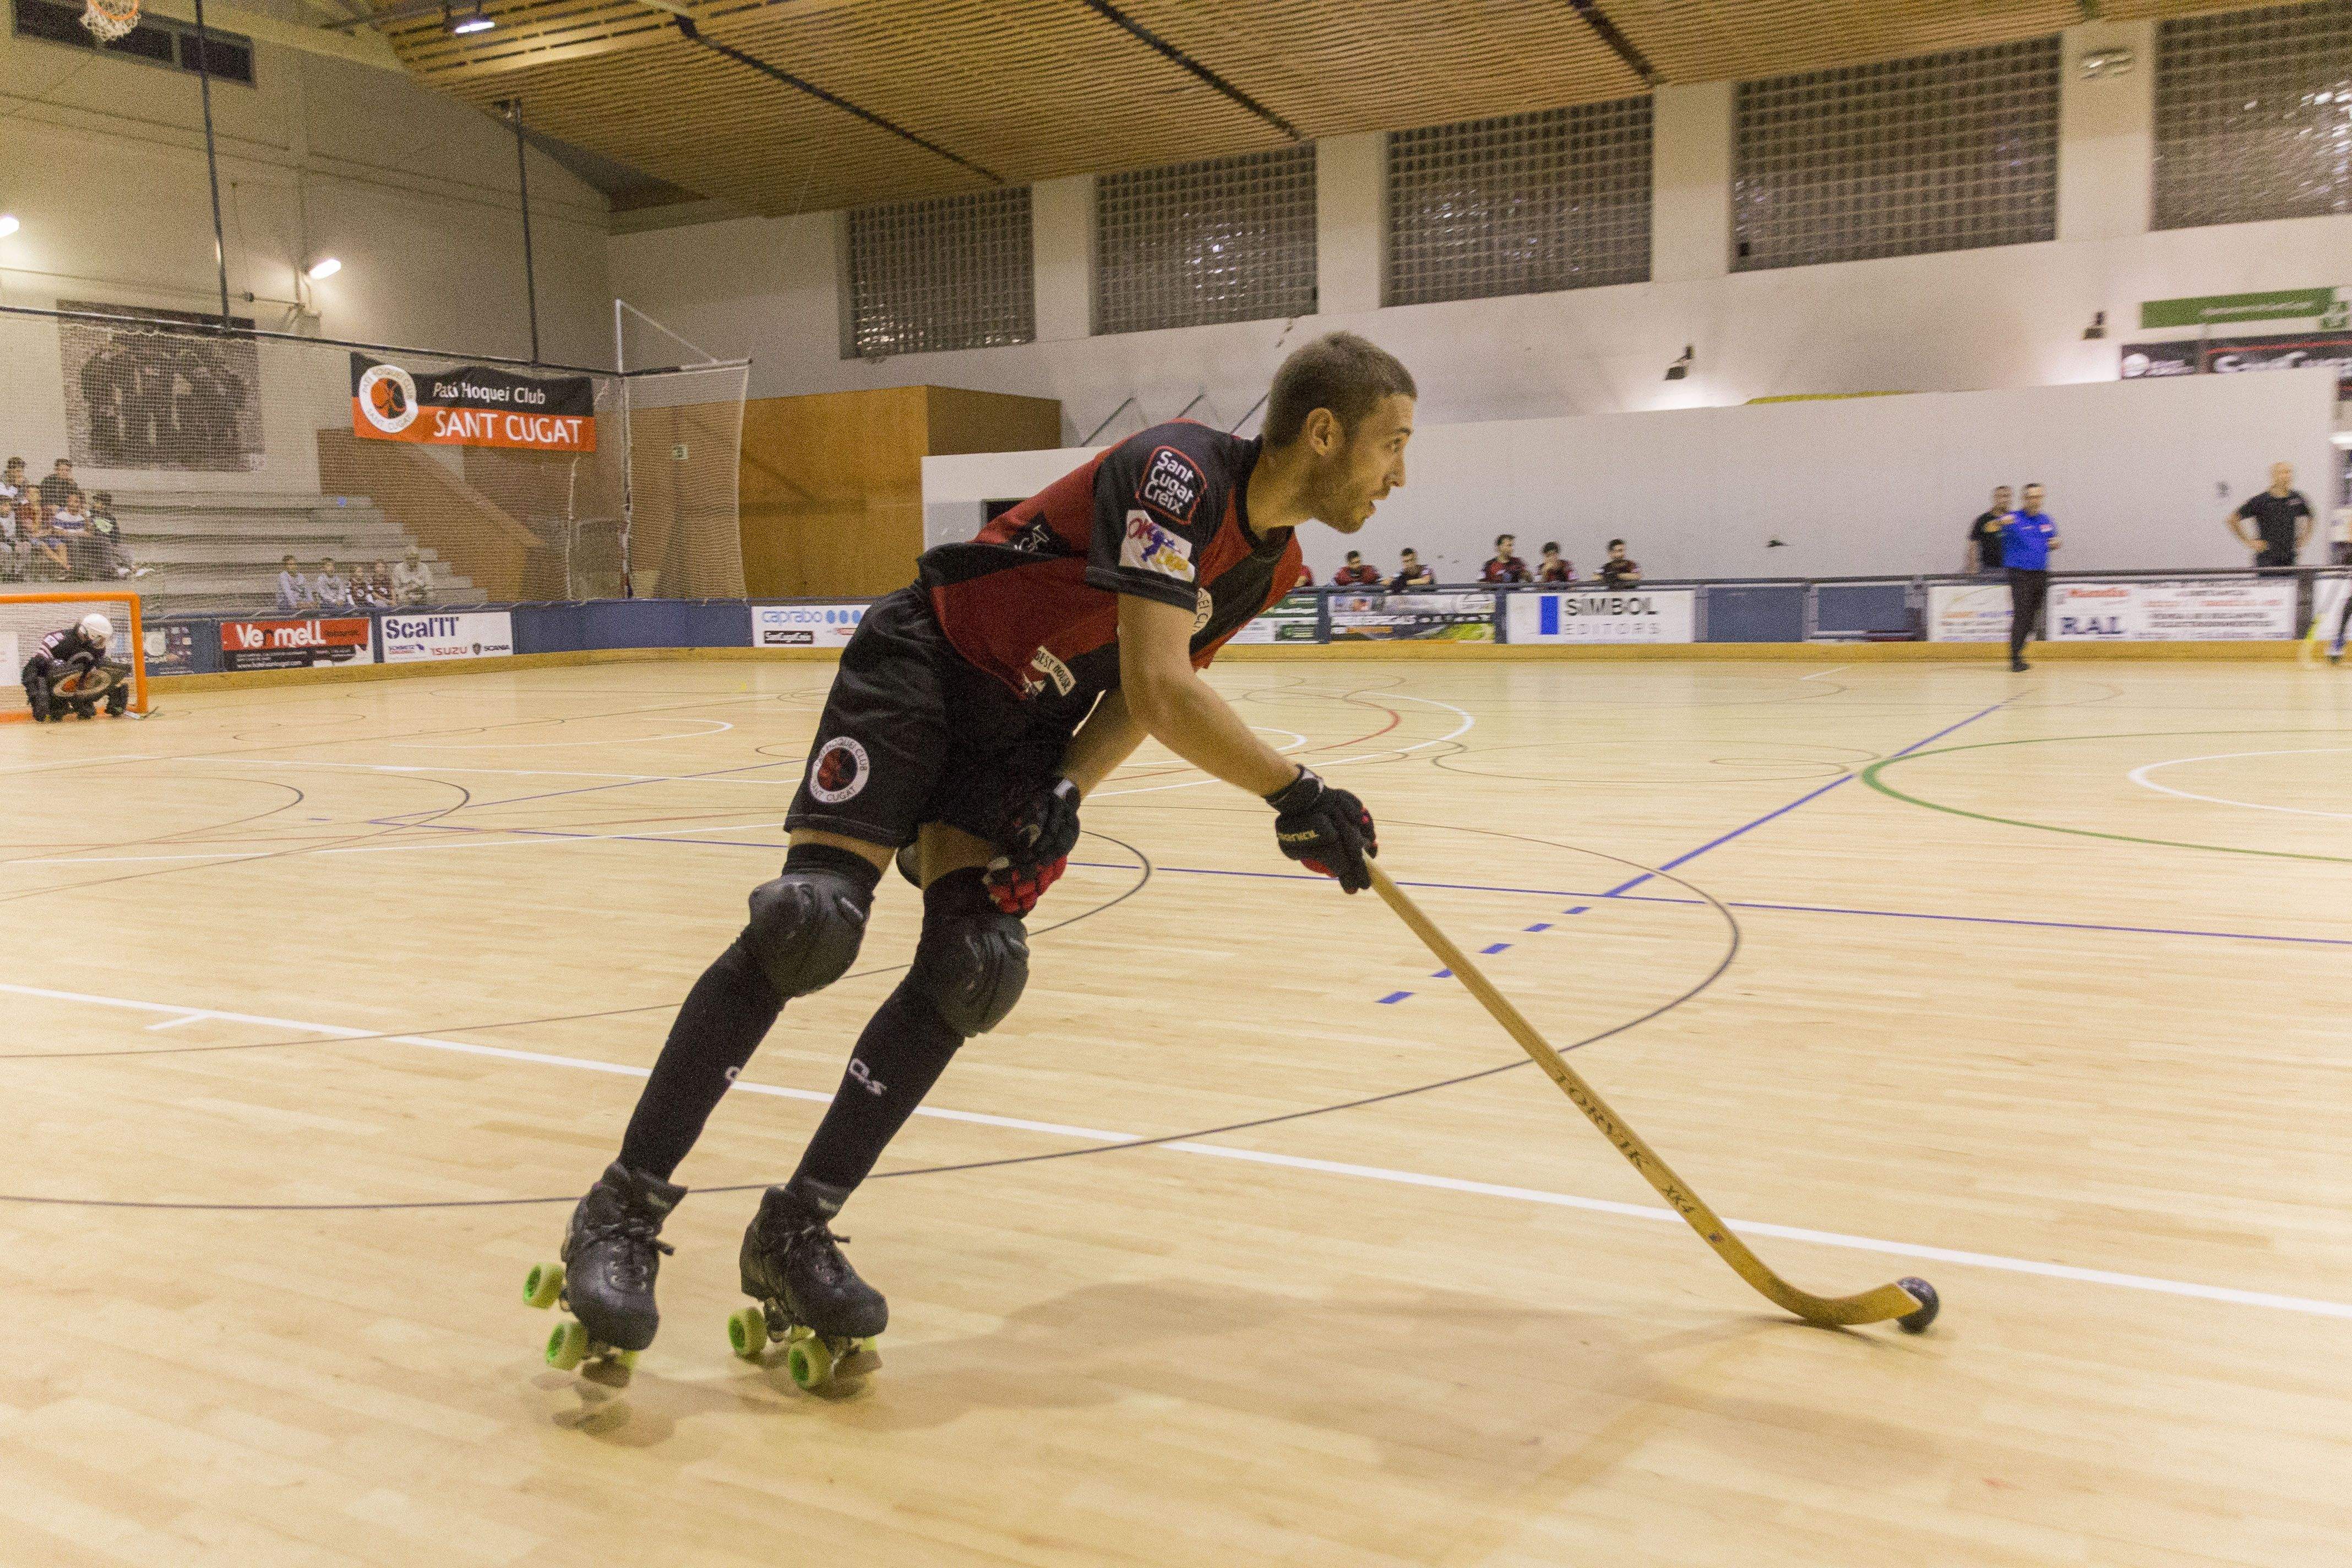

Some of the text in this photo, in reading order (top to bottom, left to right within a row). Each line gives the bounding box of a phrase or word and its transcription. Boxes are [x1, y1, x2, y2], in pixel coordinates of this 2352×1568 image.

[433, 383, 546, 405] Patí Hoquei Club
[433, 410, 582, 444] SANT CUGAT
[1157, 451, 1194, 482] Sant
[1151, 466, 1194, 503] Cugat
[1145, 479, 1184, 515] Creix
[762, 609, 823, 626] caprabo
[1565, 597, 1658, 617] SIMBOL
[236, 620, 326, 647] Vermell
[1565, 623, 1661, 635] EDITORS
[430, 646, 468, 656] ISUZU
[856, 749, 868, 771] CLUB
[826, 786, 856, 802] CUGAT
